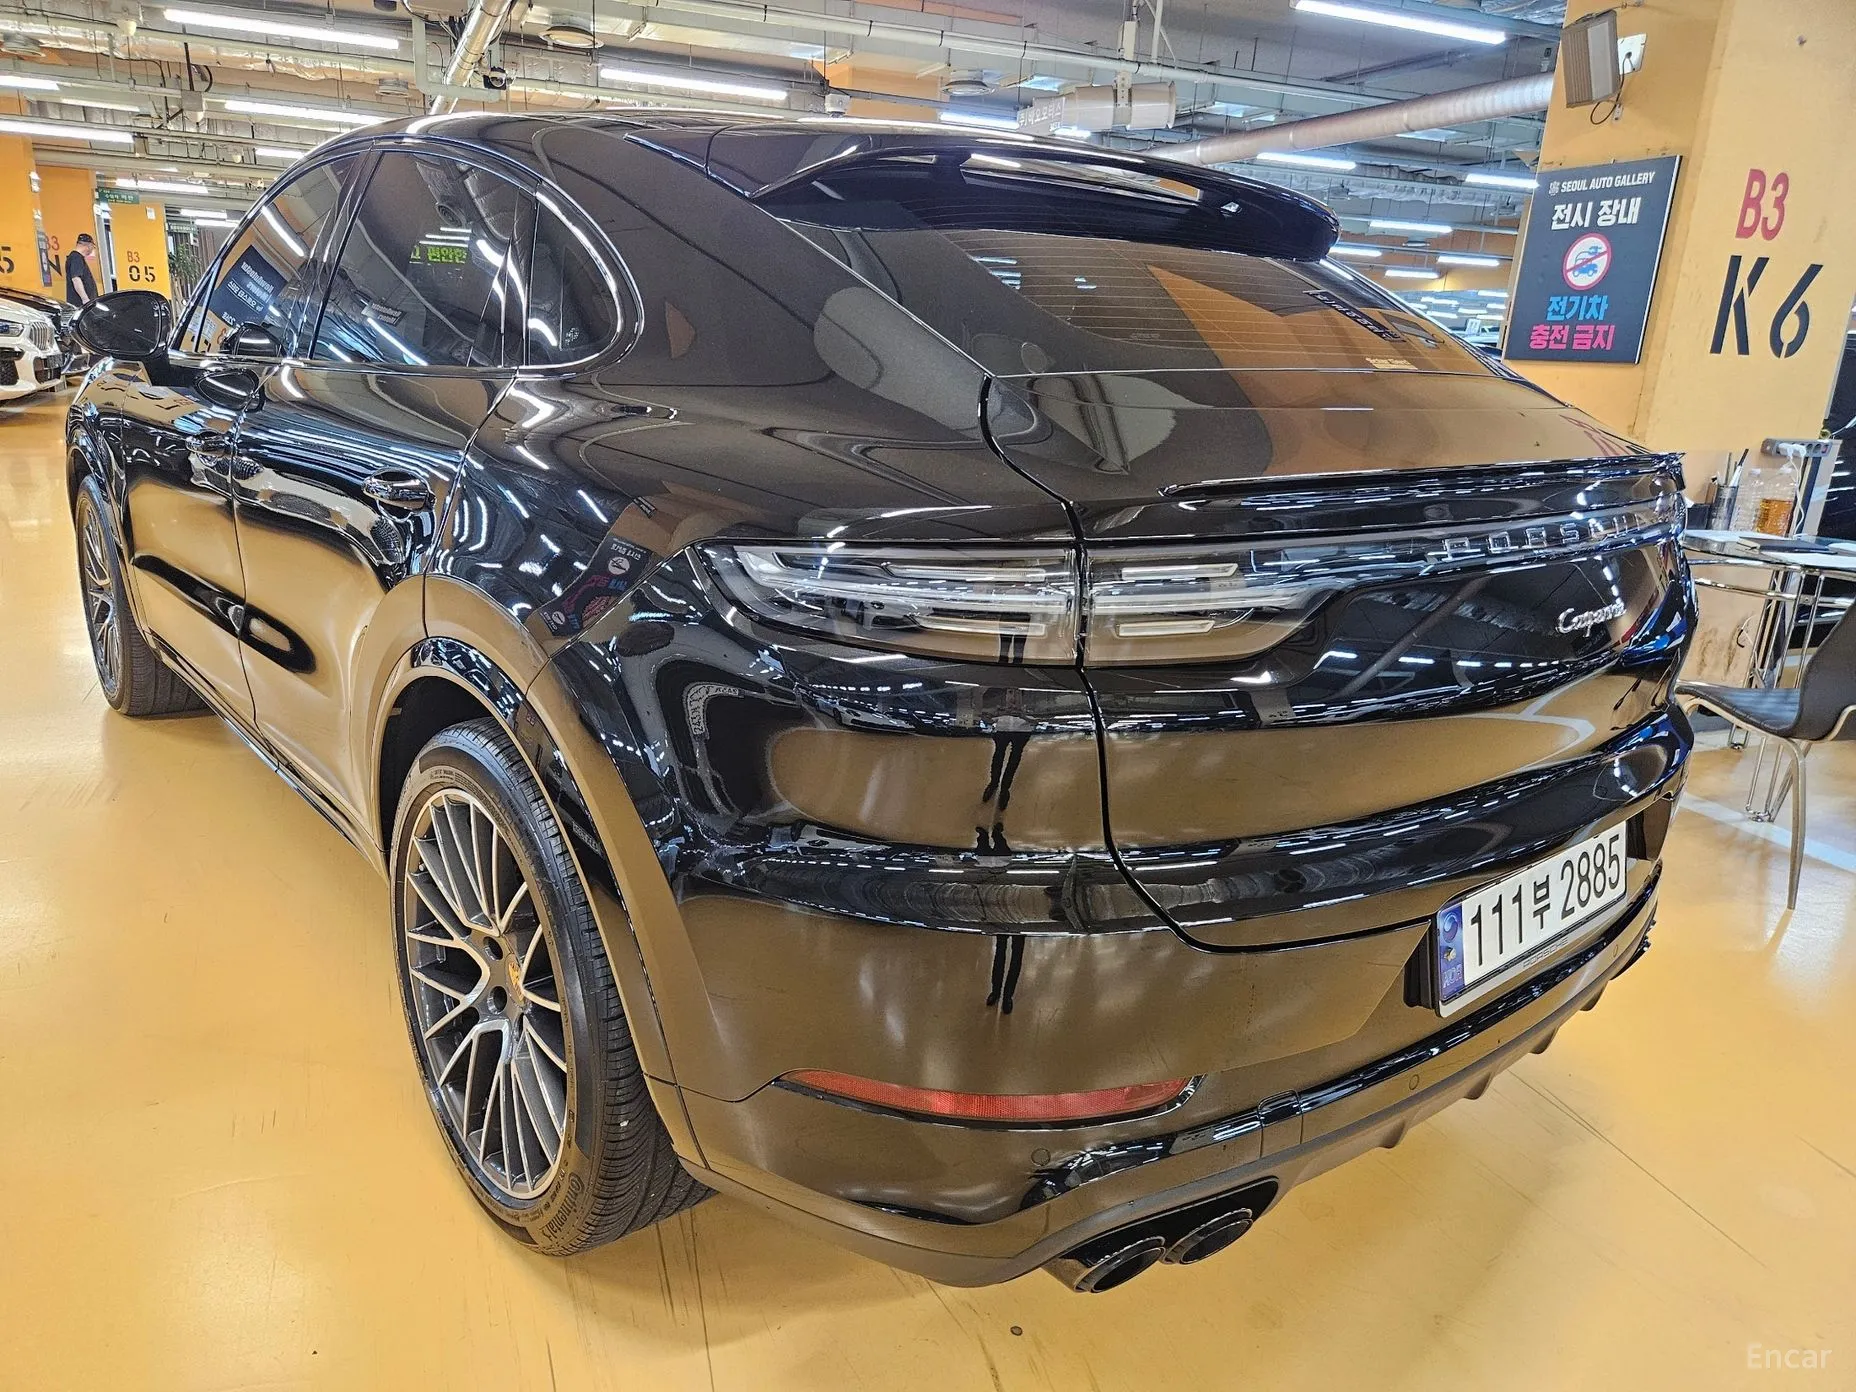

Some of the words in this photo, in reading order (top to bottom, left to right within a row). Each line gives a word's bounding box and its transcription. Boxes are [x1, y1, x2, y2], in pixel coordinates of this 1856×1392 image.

[1561, 179, 1588, 193] SEOUL
[1589, 176, 1613, 189] AUTO
[1614, 172, 1656, 187] GALLERY
[1551, 202, 1593, 230] 전시
[1597, 197, 1642, 227] 장내
[1735, 168, 1790, 241] B3
[127, 251, 141, 263] B3
[1546, 295, 1609, 321] 전기차
[1529, 324, 1570, 350] 충전
[1572, 325, 1616, 350] 금지
[1470, 873, 1551, 967] 111부
[1560, 833, 1621, 921] 2885
[1522, 936, 1569, 968] PORSCHE
[545, 1171, 585, 1239] Continental
